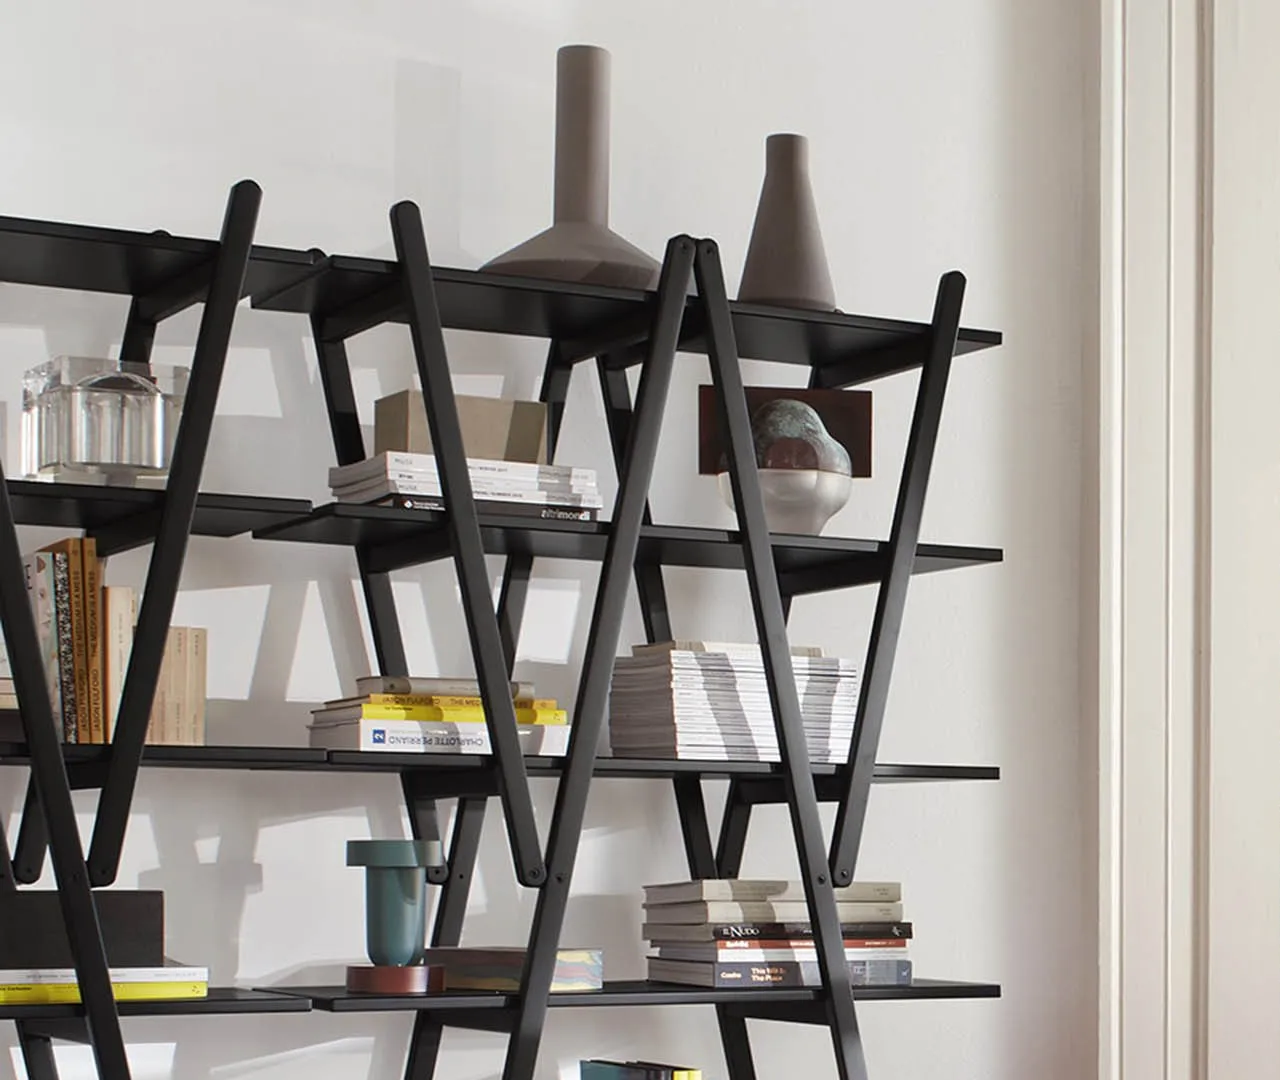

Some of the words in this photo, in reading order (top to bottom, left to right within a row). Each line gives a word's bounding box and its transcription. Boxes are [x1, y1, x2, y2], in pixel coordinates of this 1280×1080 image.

[91, 669, 100, 706] FULFORD
[92, 707, 100, 732] JASON
[388, 736, 433, 746] PERRIAND
[434, 736, 484, 746] CHARLOTTE
[730, 926, 760, 937] NUDO
